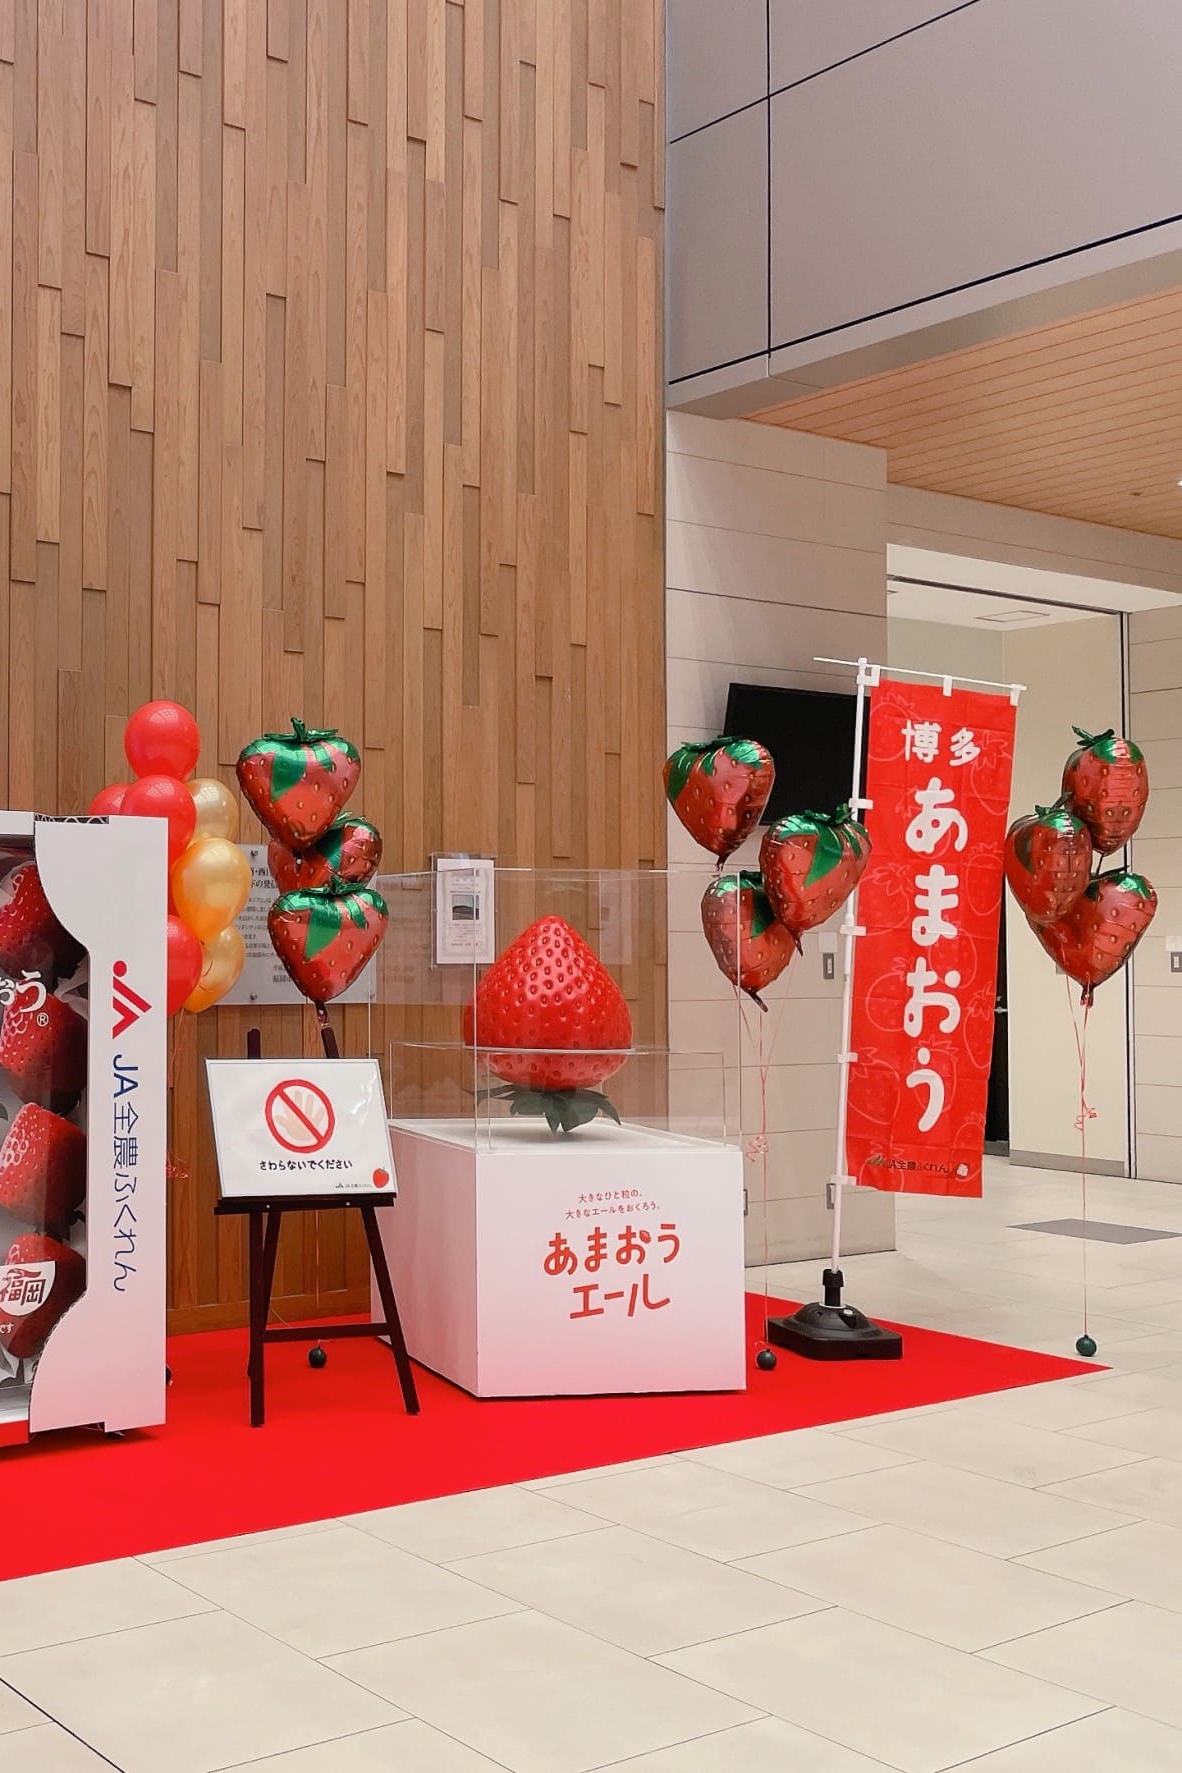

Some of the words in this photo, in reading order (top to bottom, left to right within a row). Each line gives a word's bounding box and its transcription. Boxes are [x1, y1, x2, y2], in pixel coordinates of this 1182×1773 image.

[901, 719, 981, 768] 博多
[903, 776, 968, 1133] あまおう
[113, 1054, 139, 1293] JA全農ふくれん
[259, 1159, 353, 1171] さわらないでください
[543, 1223, 680, 1276] あまおう
[0, 1268, 47, 1306] 福岡
[570, 1273, 671, 1319] エール
